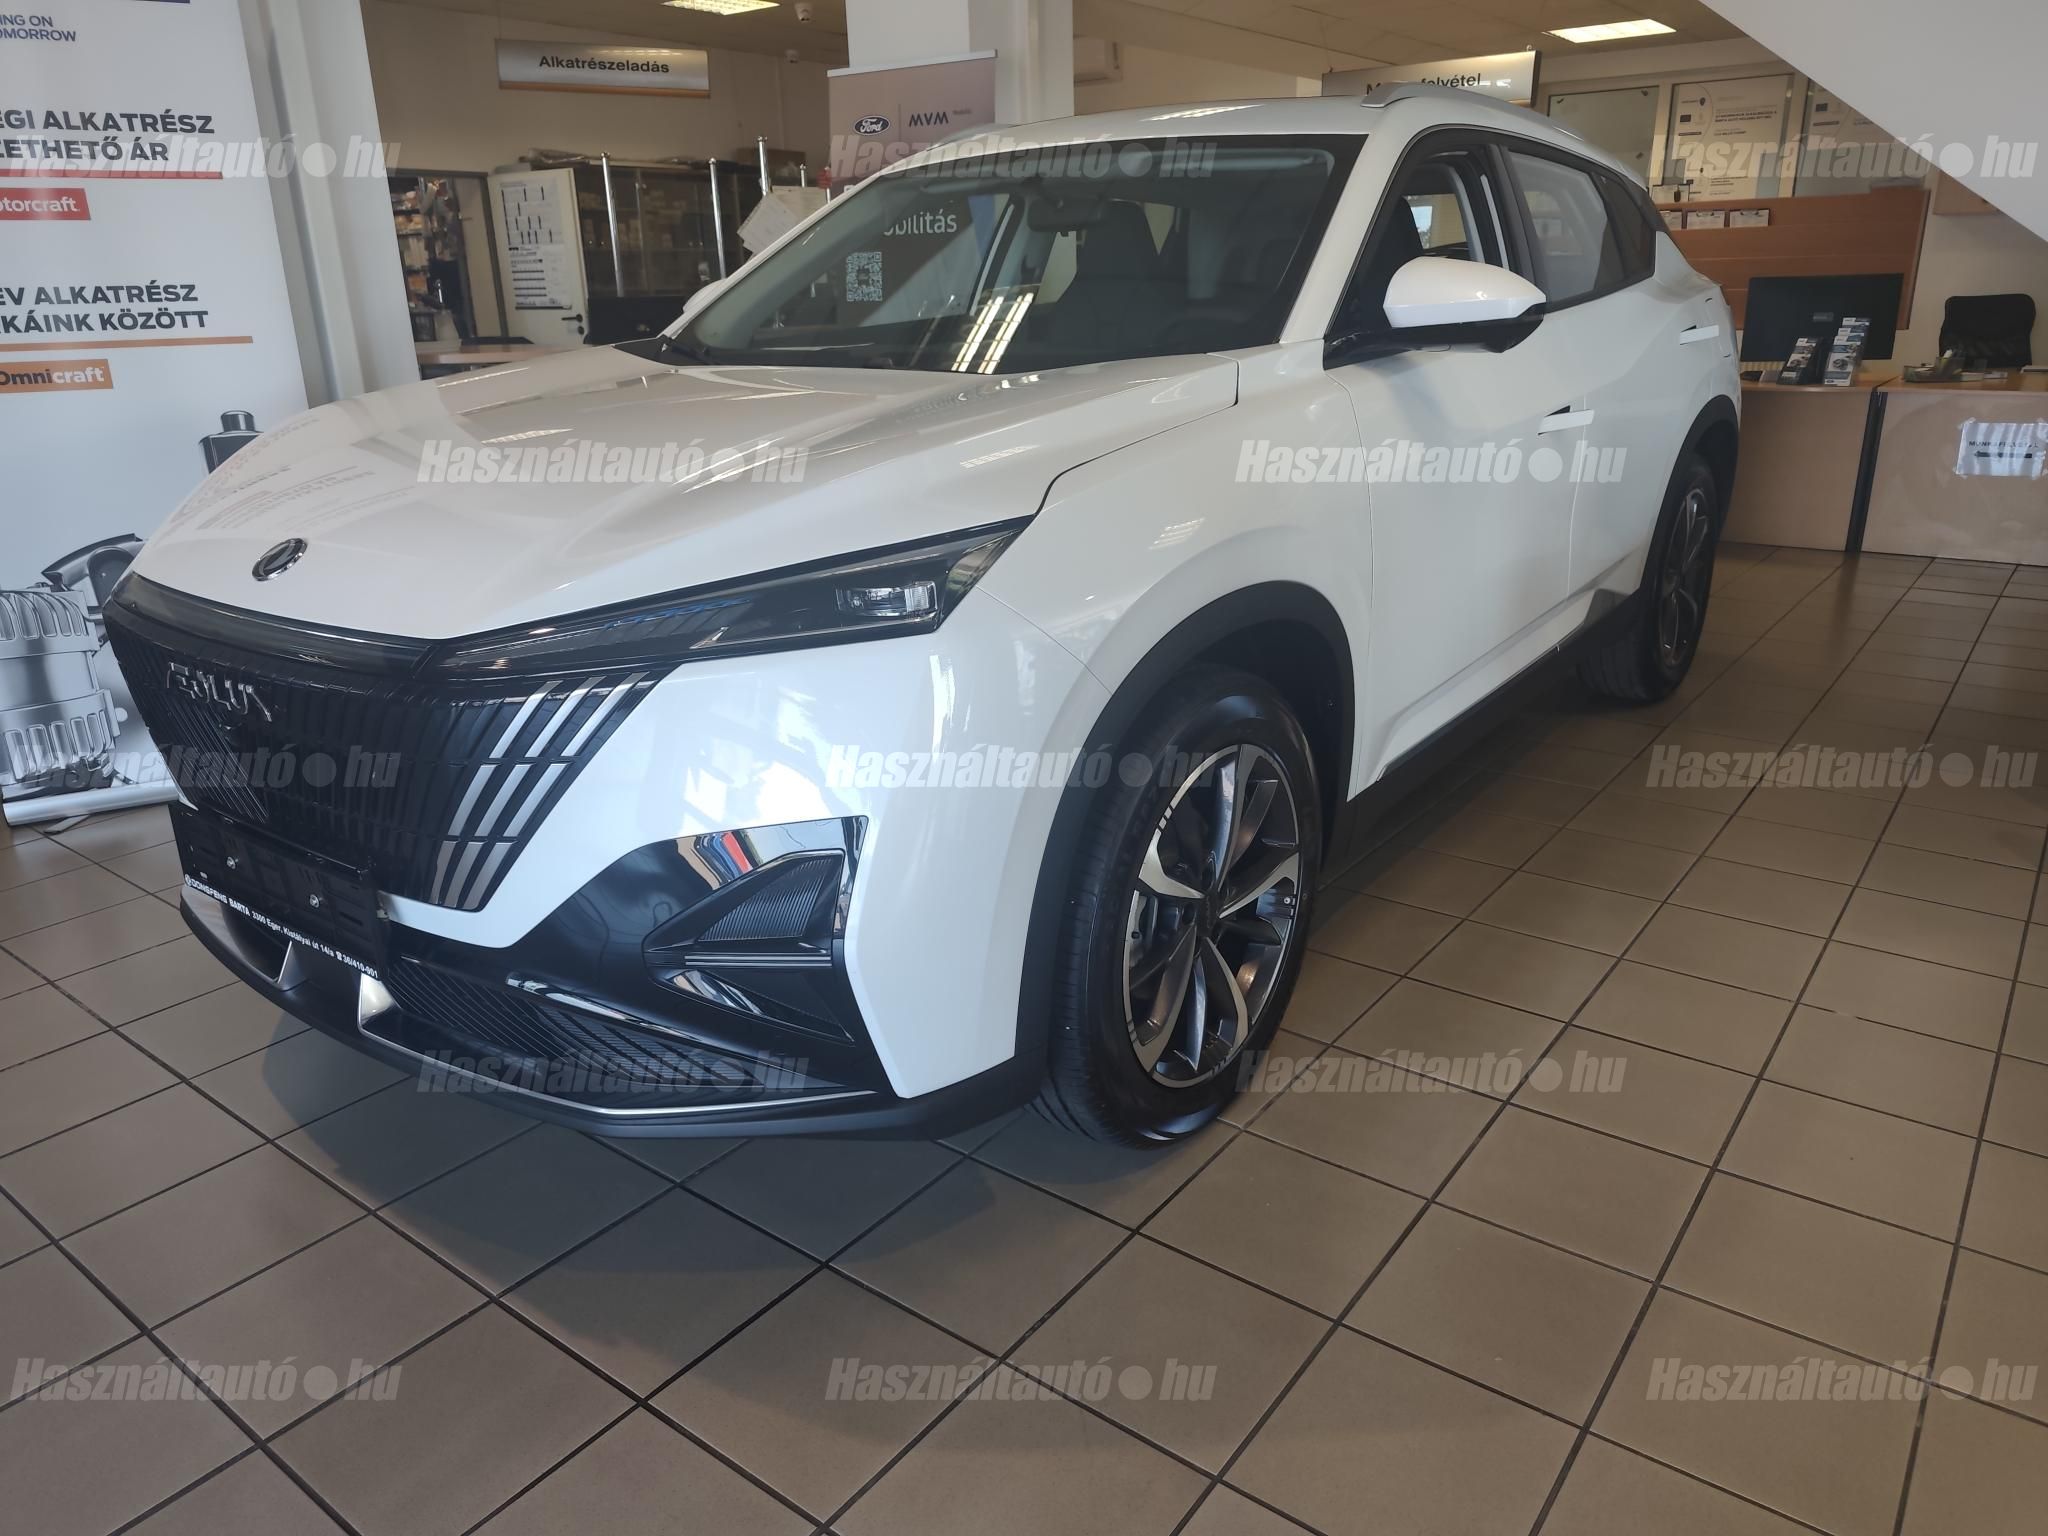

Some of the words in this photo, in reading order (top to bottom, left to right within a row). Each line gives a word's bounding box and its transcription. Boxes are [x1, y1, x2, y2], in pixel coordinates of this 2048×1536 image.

[28, 15, 54, 28] ON
[0, 28, 77, 42] MORROW
[538, 55, 671, 73] Alkatrészeladás
[0, 109, 36, 130] GI
[43, 109, 216, 134] ALKATRÉSZ
[908, 111, 949, 128] MVM
[130, 136, 169, 161] ÁR
[34, 279, 199, 305] ALKATRÉSZ
[99, 307, 209, 331] KÖZÖTT
[0, 366, 105, 386] Omnicraft
[191, 879, 228, 904] DONGFENG
[229, 898, 251, 916] BARTA
[252, 911, 266, 925] 3300
